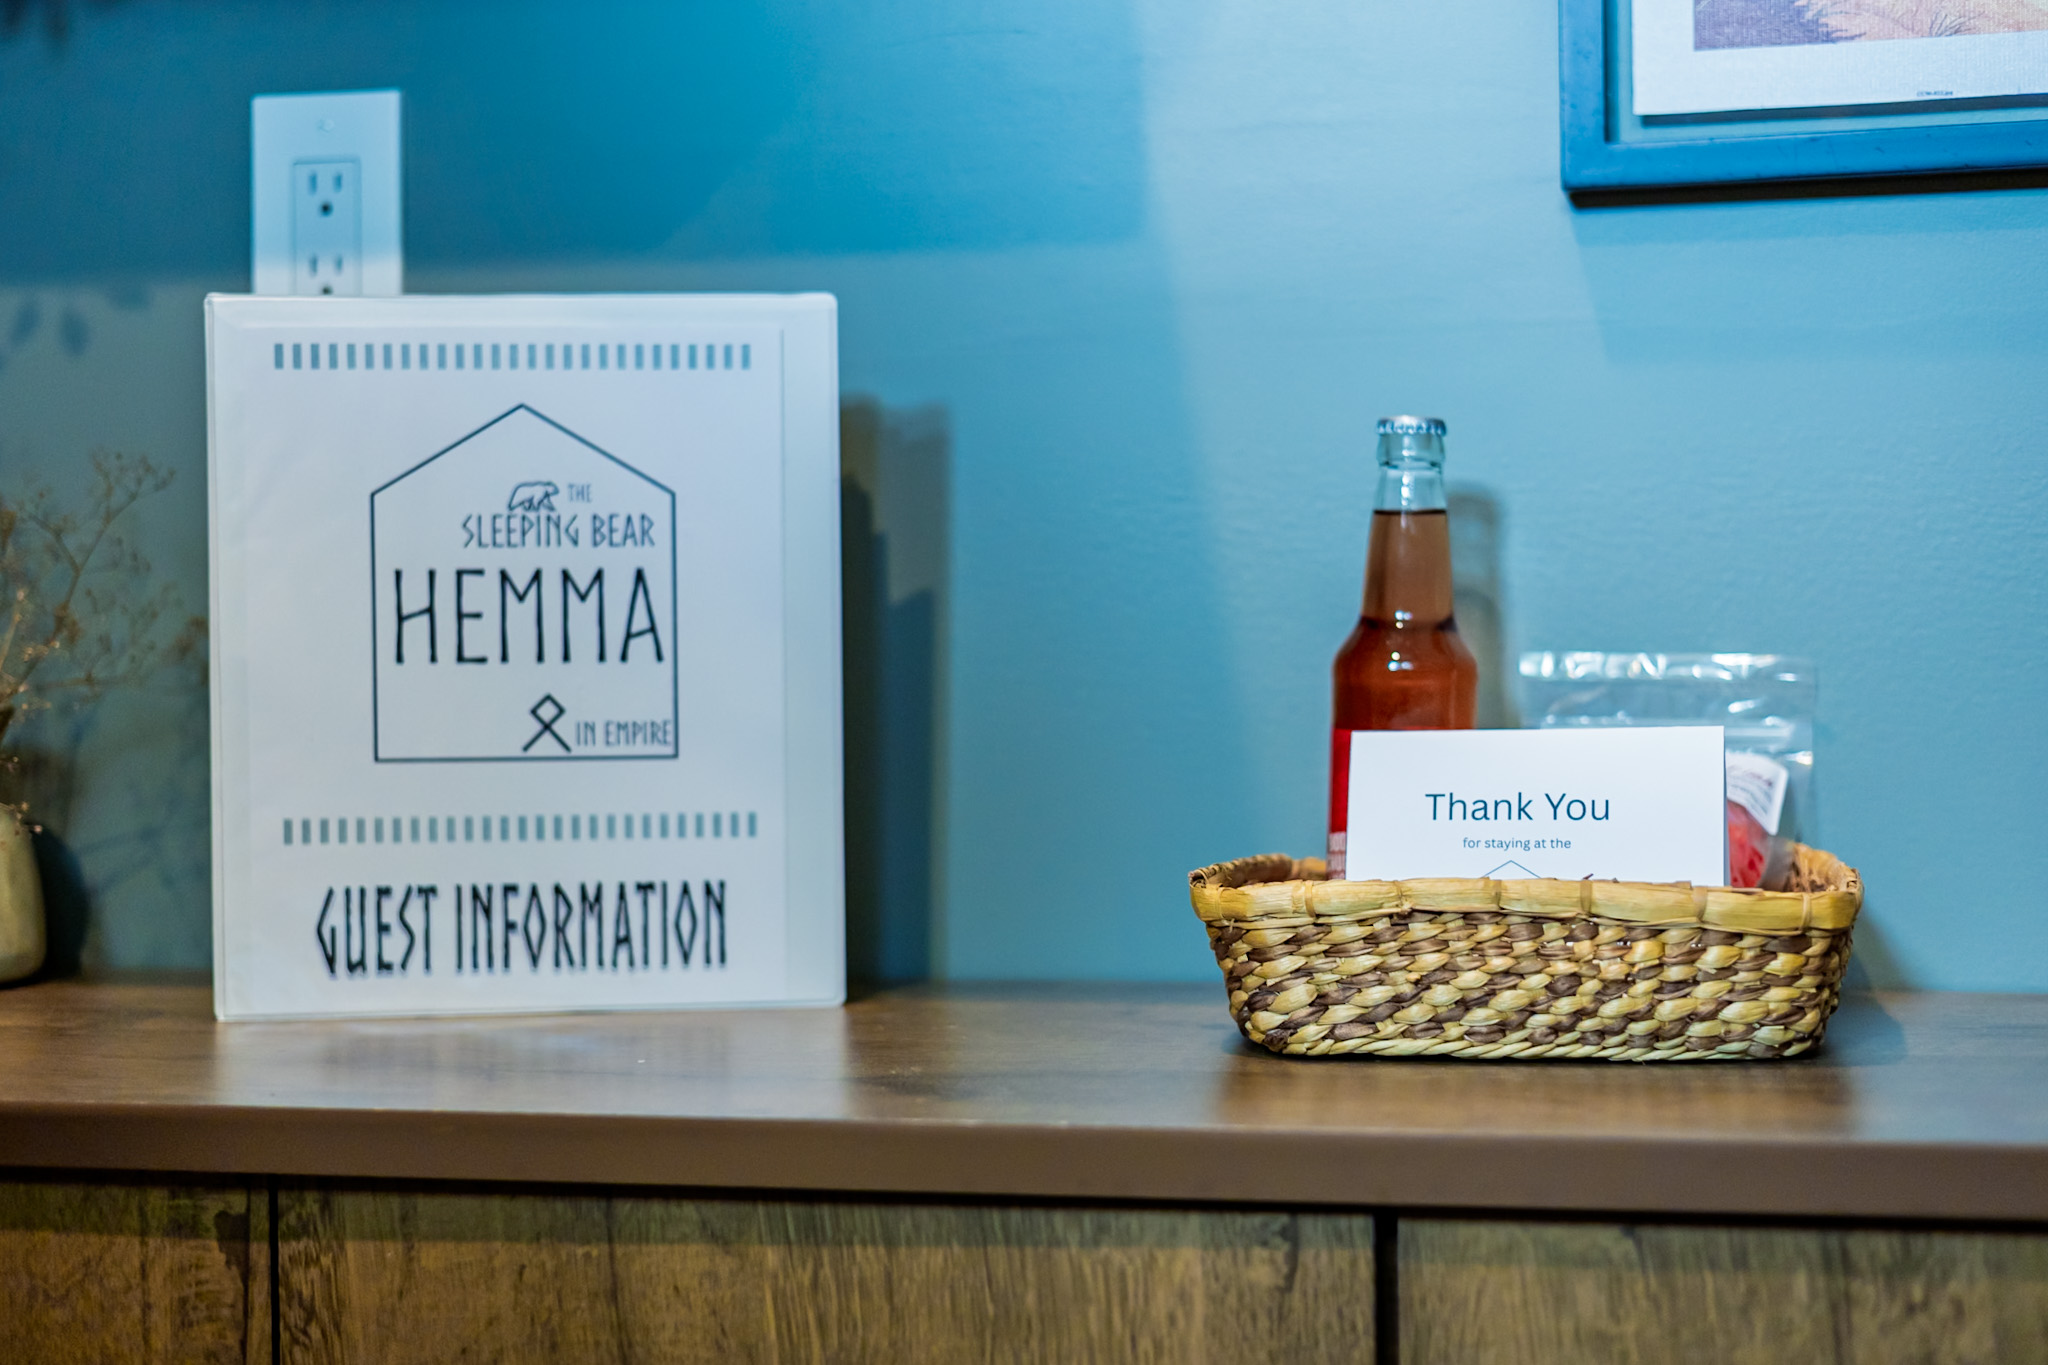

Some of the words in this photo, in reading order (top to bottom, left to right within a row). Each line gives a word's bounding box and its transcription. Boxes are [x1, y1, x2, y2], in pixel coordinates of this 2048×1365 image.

[567, 482, 592, 503] THE
[461, 513, 579, 549] SLEEPING
[591, 513, 655, 548] BEAR
[394, 567, 664, 665] HEMMA
[576, 721, 596, 747] IN
[604, 719, 672, 747] EMPIRE
[1425, 792, 1534, 821] Thank
[1545, 792, 1610, 821] You
[1462, 836, 1482, 849] for
[1484, 838, 1531, 852] staying
[1533, 839, 1547, 849] at
[1549, 837, 1572, 849] the
[315, 884, 438, 978] GUEST
[455, 879, 727, 973] INFORMATION
